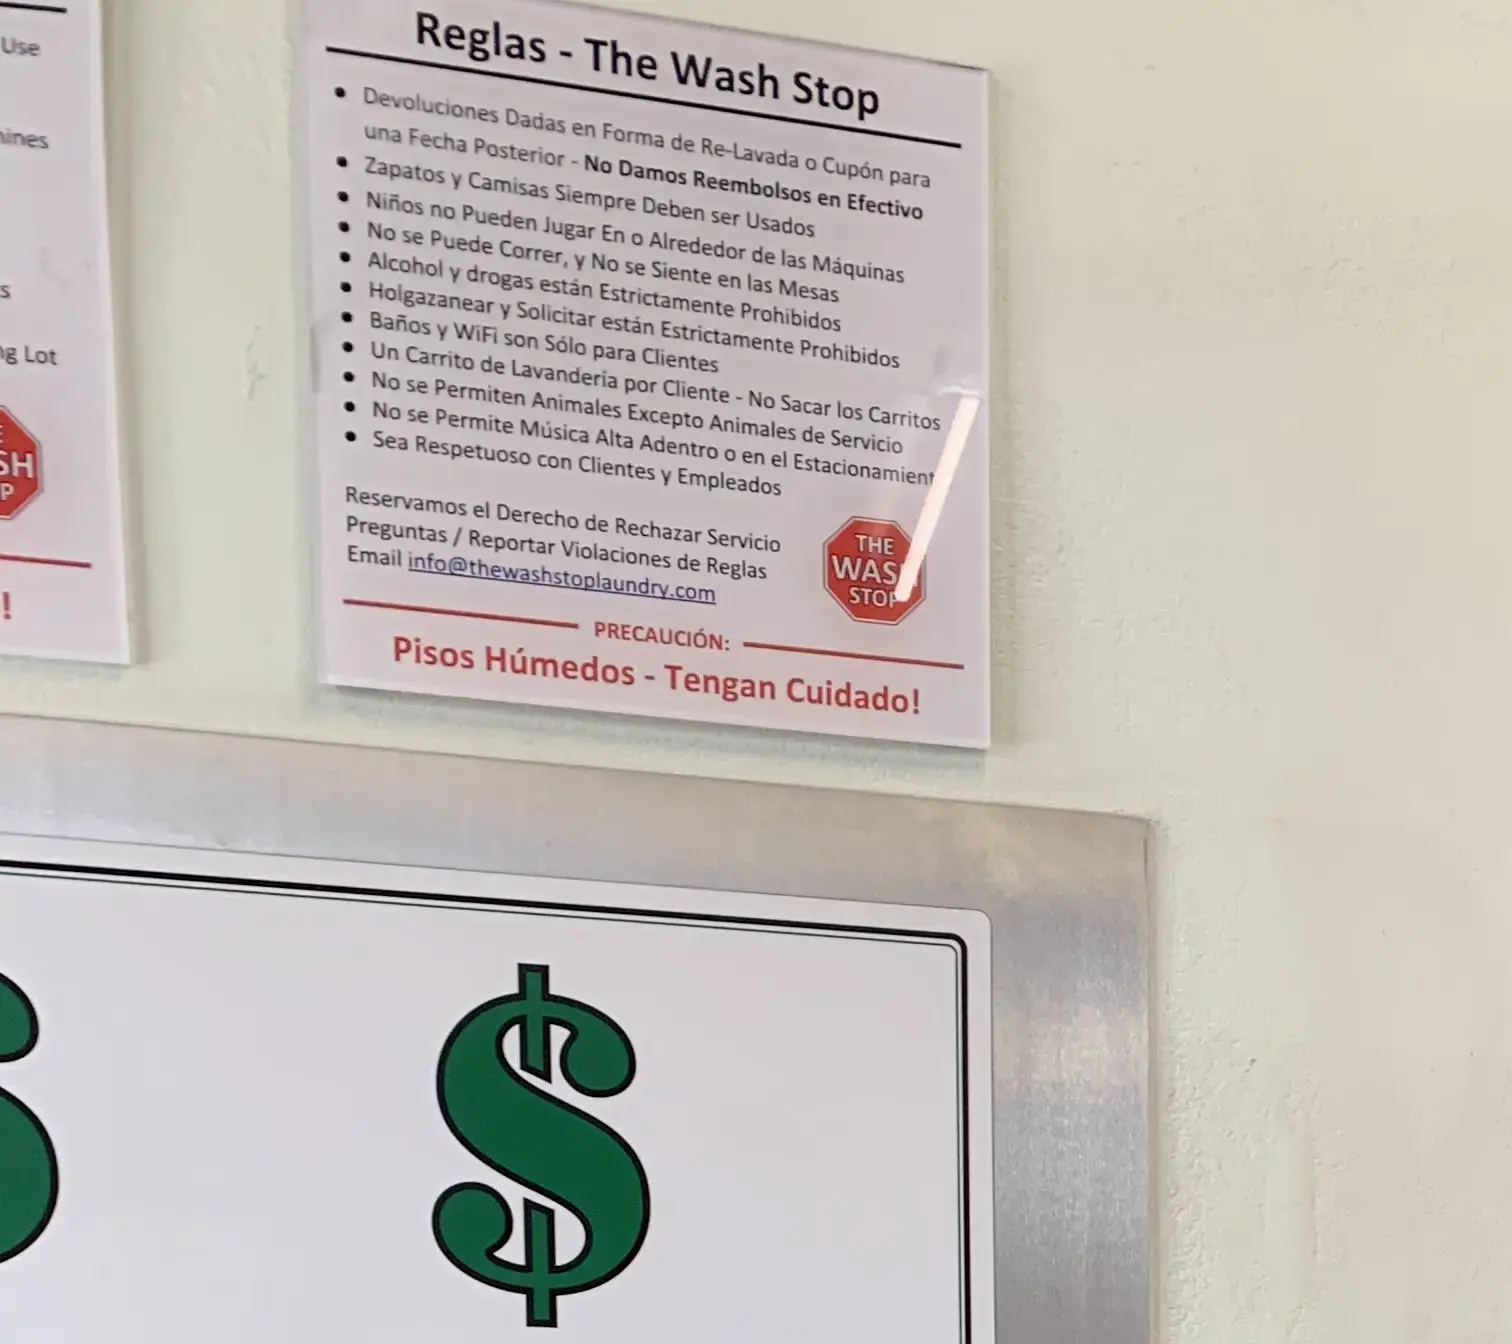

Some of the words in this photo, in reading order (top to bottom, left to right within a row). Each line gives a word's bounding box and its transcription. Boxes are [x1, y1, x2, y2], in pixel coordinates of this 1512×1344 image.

[0, 36, 41, 57] Use
[415, 10, 546, 63] Reglas
[582, 37, 658, 80] The
[669, 50, 779, 99] Wash
[792, 71, 879, 121] Stop
[363, 86, 498, 123] Devoluciones
[505, 107, 566, 134] Dadas
[571, 122, 596, 138] en
[602, 122, 664, 148] Forma
[670, 133, 695, 152] de
[701, 137, 798, 168] Re-Lavada
[804, 157, 817, 170] o
[822, 156, 883, 181] Cupón
[889, 170, 930, 188] para
[364, 125, 402, 143] una
[408, 127, 467, 153] Fecha
[473, 137, 565, 167] Posterior
[583, 153, 612, 174] No
[618, 159, 687, 185] Damos
[692, 169, 811, 204] Reembolsos
[817, 192, 841, 208] en
[847, 192, 923, 220] Efectivo
[364, 155, 445, 184] Zapatos
[450, 172, 461, 190] y
[468, 171, 549, 199] Camisas
[554, 183, 636, 211] Siempre
[642, 196, 704, 221] Deben
[710, 210, 740, 226] ser
[746, 211, 814, 237] Usados
[366, 190, 424, 215] Niños
[430, 204, 455, 220] no
[462, 203, 537, 231] Pueden
[542, 216, 596, 240] Jugar
[601, 224, 625, 243] En
[631, 232, 643, 246] o
[648, 231, 746, 260] Alrededor
[751, 245, 775, 265] de
[780, 248, 806, 269] las
[812, 254, 904, 283] Máquinas
[367, 251, 443, 277] Alcohol
[448, 266, 461, 283] y
[466, 264, 534, 291] drogas
[539, 278, 593, 298] están
[599, 282, 735, 317] Estrictamente
[740, 302, 841, 332] Prohibidos
[369, 280, 494, 313] Holgazanear
[499, 303, 510, 320] y
[516, 300, 596, 327] Solicitar
[601, 316, 654, 335] están
[660, 320, 793, 354] Estrictamente
[799, 339, 900, 368] Prohibidos
[24, 345, 57, 365] Lot
[370, 310, 431, 335] Baños
[436, 323, 447, 340] y
[453, 321, 497, 344] WiFi
[503, 332, 538, 349] son
[544, 334, 586, 355] Sólo
[593, 344, 636, 362] para
[641, 347, 718, 373] Clientes
[370, 340, 399, 360] Un
[405, 345, 474, 370] Carrito
[480, 355, 505, 374] de
[624, 377, 657, 394] por
[662, 379, 729, 403] Cliente
[748, 389, 775, 409] No
[780, 394, 831, 416] Sacar
[836, 400, 862, 420] los
[868, 405, 940, 431] Carritos
[371, 370, 400, 390] No
[406, 379, 428, 394] se
[434, 378, 525, 406] Permiten
[531, 391, 621, 418] Animales
[627, 403, 703, 428] Excepto
[708, 413, 796, 440] Animales
[801, 425, 825, 444] de
[830, 429, 902, 454] Servicio
[372, 400, 401, 420] No
[407, 408, 428, 423] se
[435, 408, 513, 434] Permite
[519, 418, 589, 443] Música
[595, 428, 633, 449] Alta
[639, 434, 718, 459] Adentro
[723, 448, 736, 462] o
[741, 450, 765, 465] en
[770, 450, 787, 468] el
[793, 452, 937, 485] Estacionamient
[372, 430, 408, 450] Sea
[415, 435, 531, 465] Respetuoso
[536, 454, 572, 470] con
[577, 455, 655, 480] Clientes
[660, 469, 671, 486] y
[677, 467, 781, 496] Empleados
[345, 485, 467, 516] Reservamos
[472, 501, 489, 518] el
[496, 503, 579, 529] Derecho
[584, 513, 608, 532] de
[615, 517, 702, 543] Rechazar
[707, 528, 780, 552] Servicio
[346, 514, 447, 543] Preguntas
[468, 529, 556, 554] Reportar
[560, 539, 671, 568] Violaciones
[676, 553, 700, 572] de
[706, 556, 766, 580] Reglas
[855, 534, 894, 555] THE
[347, 544, 401, 567] Email
[407, 552, 717, 604] info@thewashstoplaundry.com
[831, 554, 916, 586] WAS
[393, 635, 474, 669] Pisos
[485, 645, 635, 685] Húmedos
[663, 663, 776, 702] Tengan
[786, 677, 919, 714] Cuidado!
[594, 620, 730, 651] PRECAUCIÓN:
